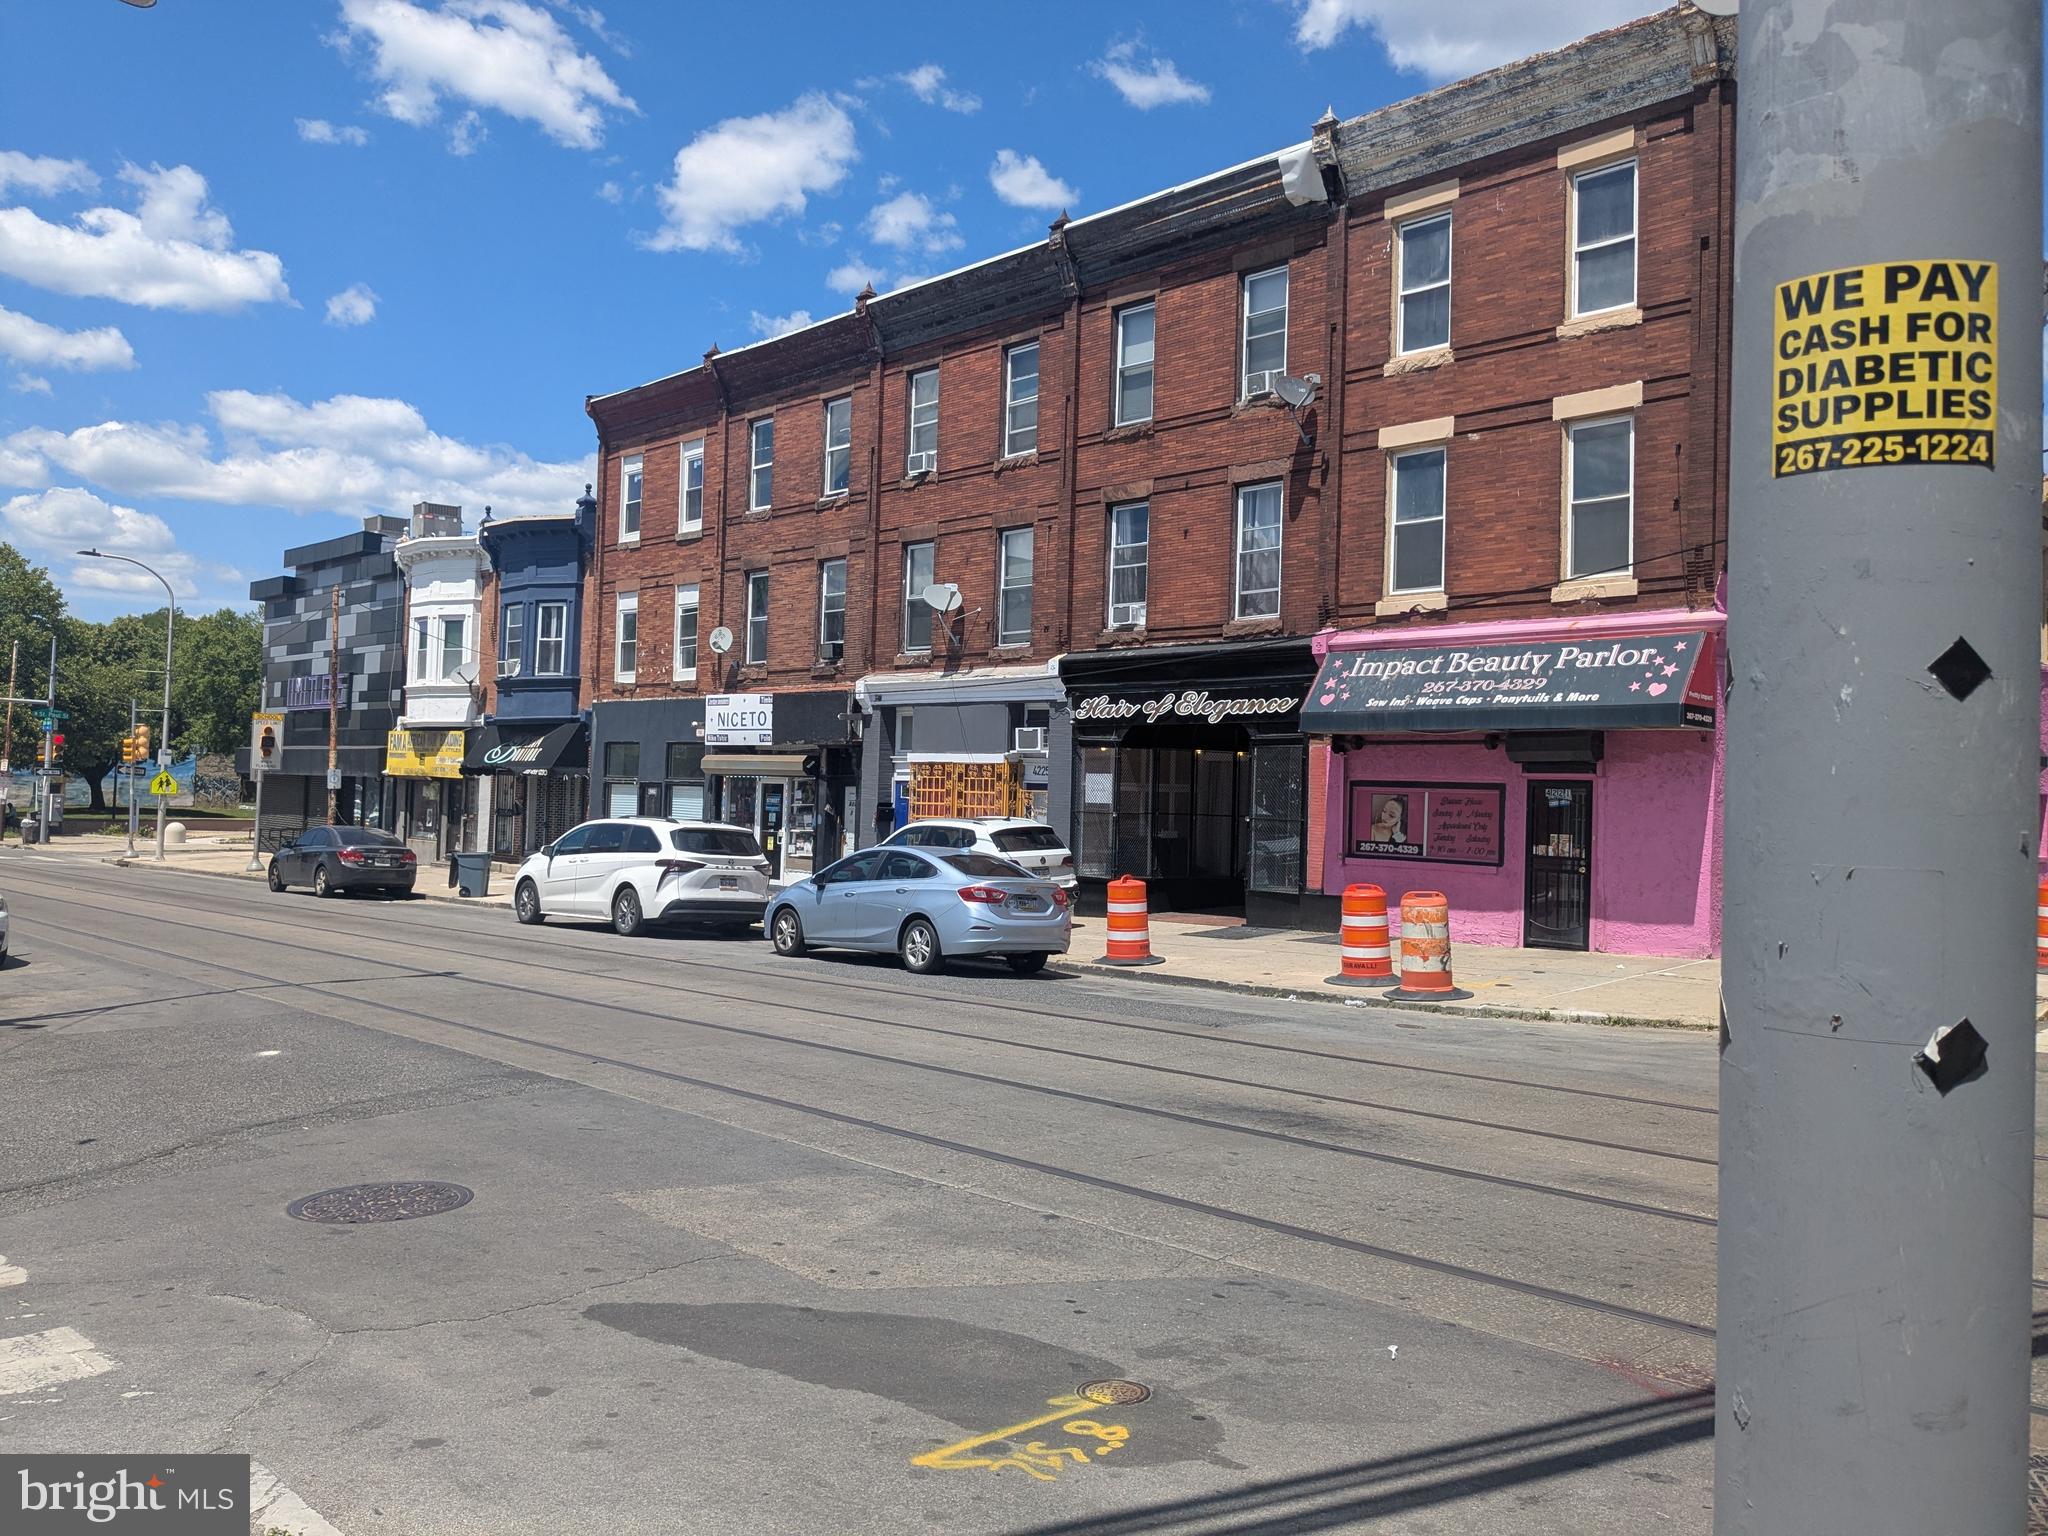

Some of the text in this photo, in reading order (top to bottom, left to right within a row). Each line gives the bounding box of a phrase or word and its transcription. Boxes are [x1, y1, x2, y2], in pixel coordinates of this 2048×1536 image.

[1780, 263, 1991, 321] WE PAY
[1779, 312, 1992, 360] CASH FOR
[1778, 351, 1992, 399] DIABETIC
[1777, 389, 1991, 433] SUPPLIES
[1780, 434, 1989, 473] 267-225-1224
[1349, 644, 1657, 680] Impact Beauty Parlor
[1415, 696, 1452, 707] Weave
[1455, 695, 1483, 706] Caps
[1553, 693, 1563, 702] &
[1565, 692, 1599, 702] More
[1423, 678, 1548, 695] 267-370-4329
[1076, 690, 1299, 724] Hair of Elegance
[1360, 843, 1418, 854] 267-370-4329
